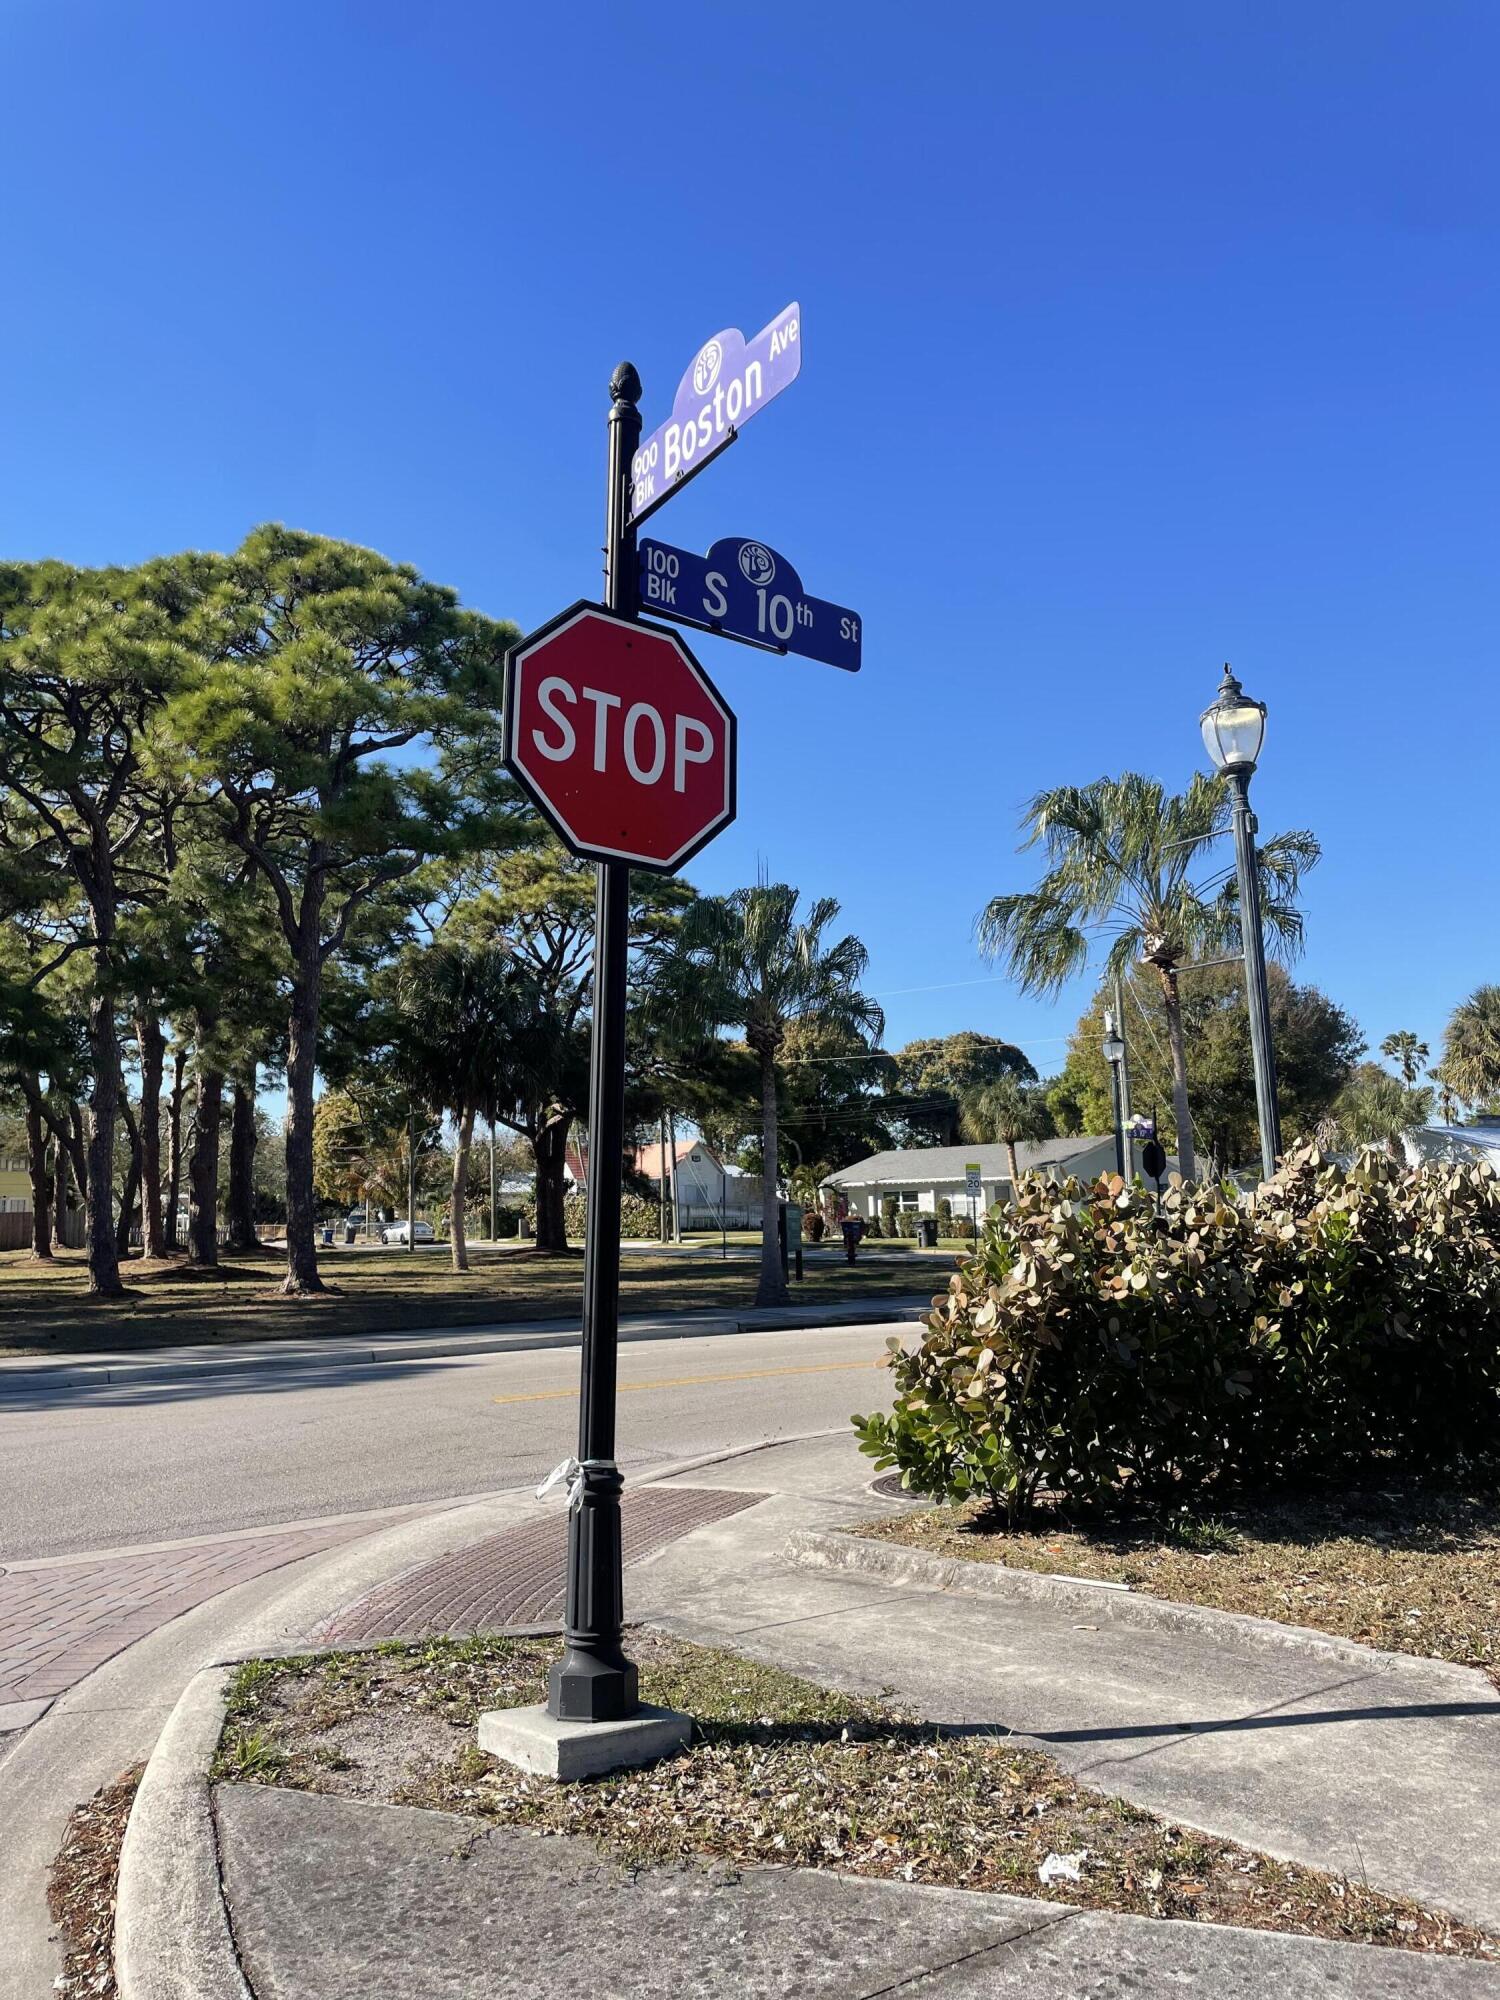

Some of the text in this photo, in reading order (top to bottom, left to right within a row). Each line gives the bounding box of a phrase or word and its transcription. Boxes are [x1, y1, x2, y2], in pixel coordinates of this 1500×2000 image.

[665, 319, 798, 480] Boston Ave
[634, 441, 658, 482] 900
[636, 474, 655, 509] Blk
[647, 547, 679, 579] 100
[647, 573, 677, 605] Blk
[702, 571, 858, 643] S 10th St
[532, 676, 714, 793] STOP
[967, 1179, 980, 1188] 20
